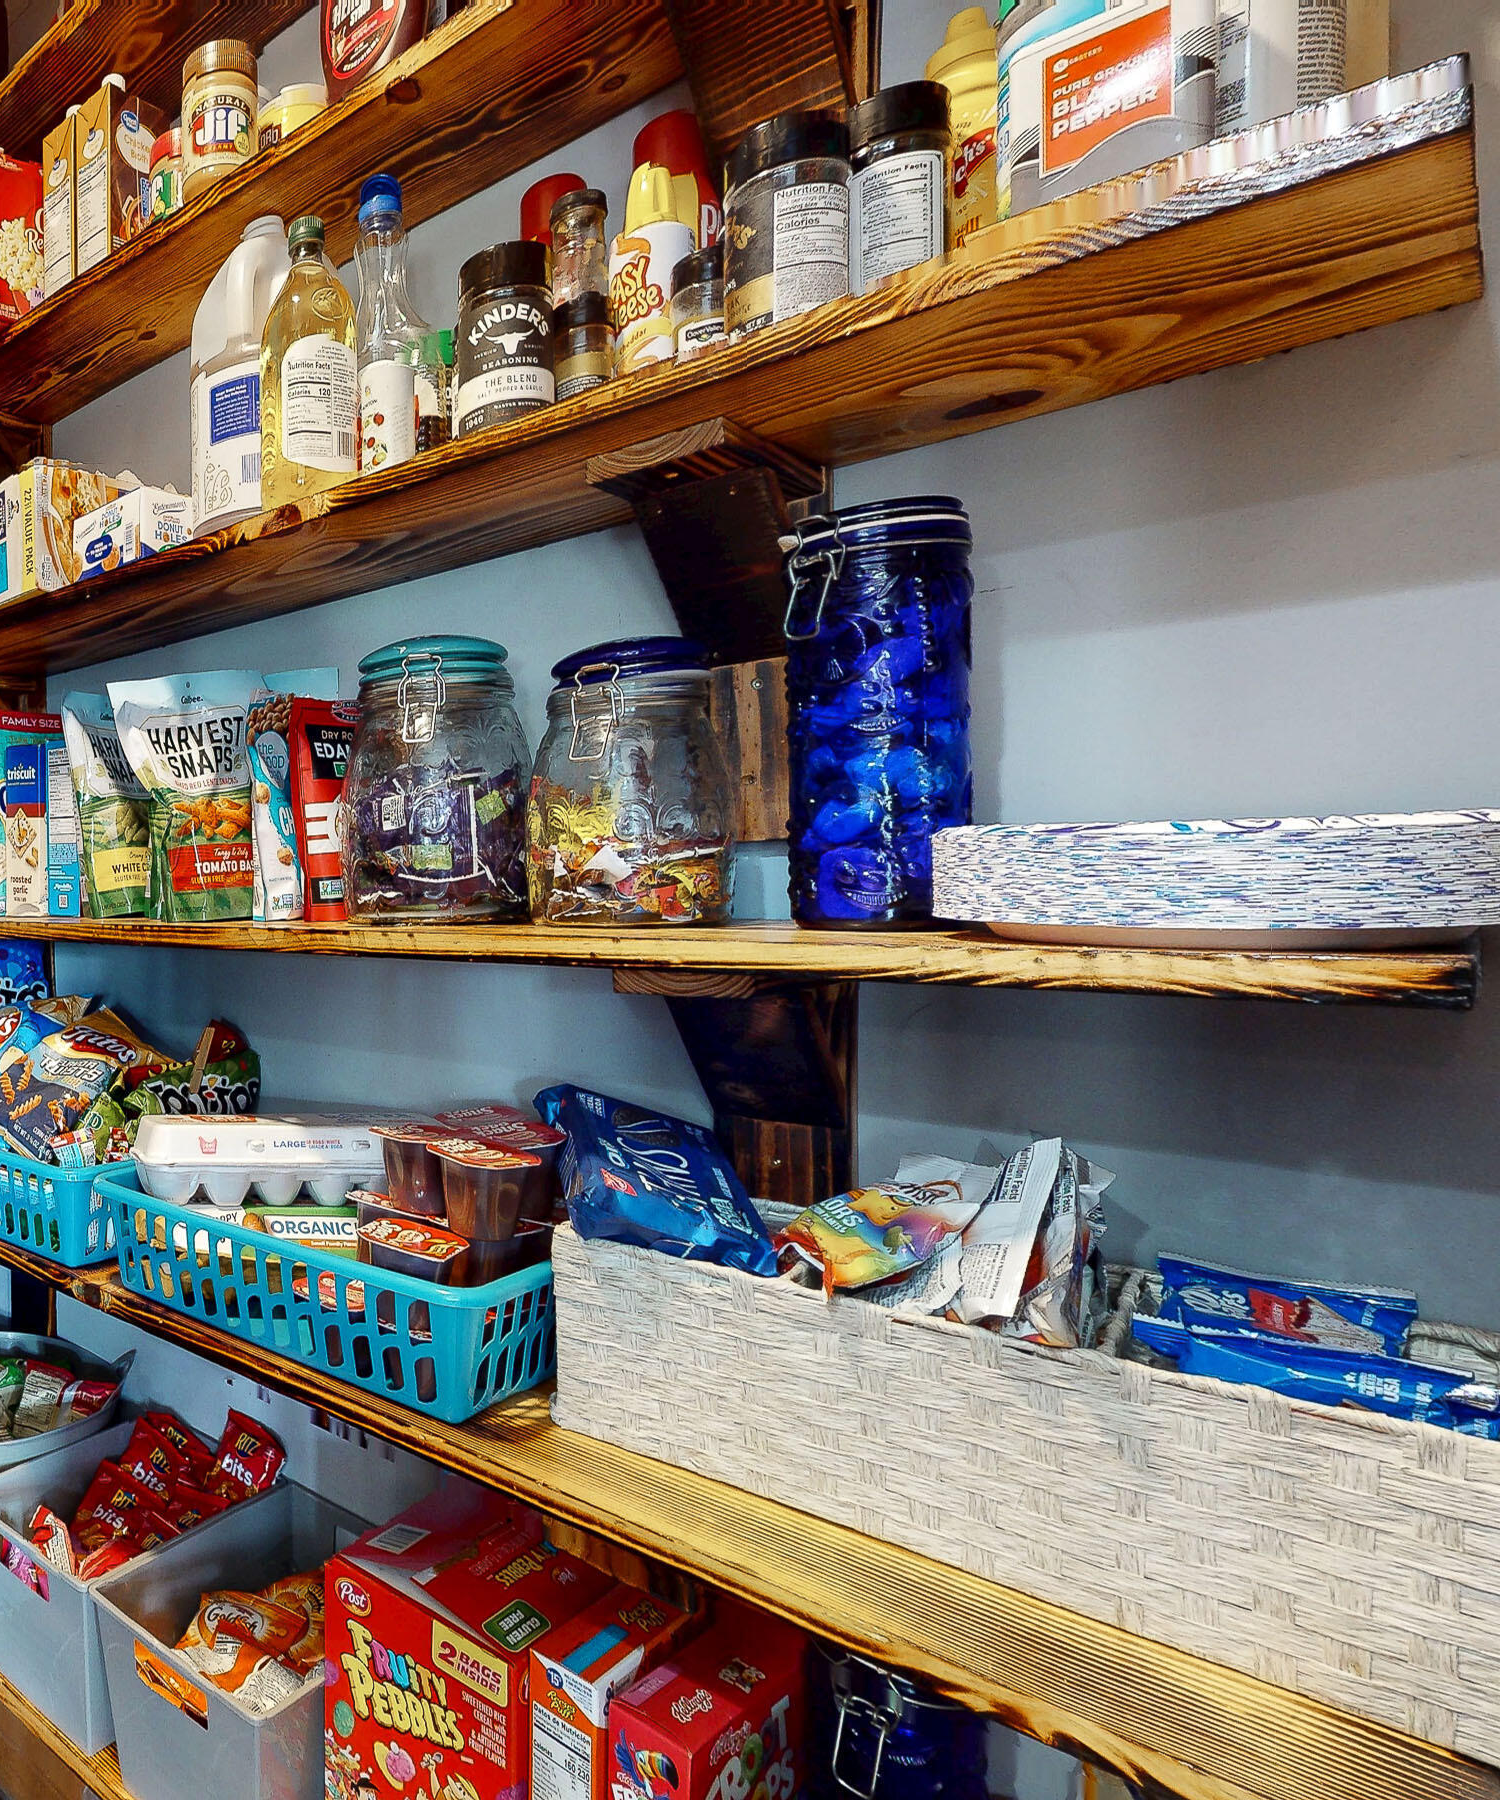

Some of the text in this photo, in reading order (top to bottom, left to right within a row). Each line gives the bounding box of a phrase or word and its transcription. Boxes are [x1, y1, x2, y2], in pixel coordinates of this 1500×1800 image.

[1051, 76, 1092, 101] PURE
[195, 96, 248, 113] NATURAL
[1051, 87, 1158, 139] PEPPER
[195, 108, 247, 146] Jif
[776, 185, 824, 200] Nutrition
[775, 215, 820, 231] Calories
[467, 302, 550, 347] KINDER'S
[287, 361, 331, 372] Nutrition Facts
[481, 356, 539, 372] SEASONING
[485, 373, 538, 389] THE BLEND
[287, 388, 331, 398] Calories 120
[24, 510, 33, 545] VALUE
[155, 531, 188, 543] HOLES
[157, 522, 185, 534] DONUT
[25, 546, 34, 576] PACK
[1, 716, 61, 729] FAMILY SIZE
[147, 715, 245, 756] HARVEST
[321, 729, 339, 741] DRY
[257, 741, 274, 755] the
[7, 765, 37, 780] triscuit
[168, 749, 234, 779] SNAPS
[111, 862, 140, 874] WHITE
[194, 861, 237, 875] TOMATO
[10, 874, 33, 885] roasted
[12, 885, 29, 896] garlic
[61, 1025, 137, 1063] Fritos
[273, 1139, 307, 1149] LARGE
[270, 1220, 355, 1237] ORGANIC
[234, 1432, 263, 1455] RITZ
[131, 1461, 167, 1492] bits
[220, 1453, 254, 1487] bits
[91, 1503, 126, 1530] bits
[340, 1581, 366, 1608] Post
[498, 1609, 525, 1632] FREE
[505, 1616, 541, 1646] GLUTEN
[438, 1640, 502, 1685] 2 BAGS
[456, 1662, 501, 1696] INSIDE!
[340, 1652, 466, 1752] PEBBLES
[533, 1702, 551, 1720] Datos
[473, 1709, 493, 1728] CEREAL
[493, 1711, 507, 1727] RICE
[481, 1724, 507, 1748] NATURAL
[468, 1738, 507, 1769] FRUIT FLAVOR
[564, 1758, 591, 1783] 160 230
